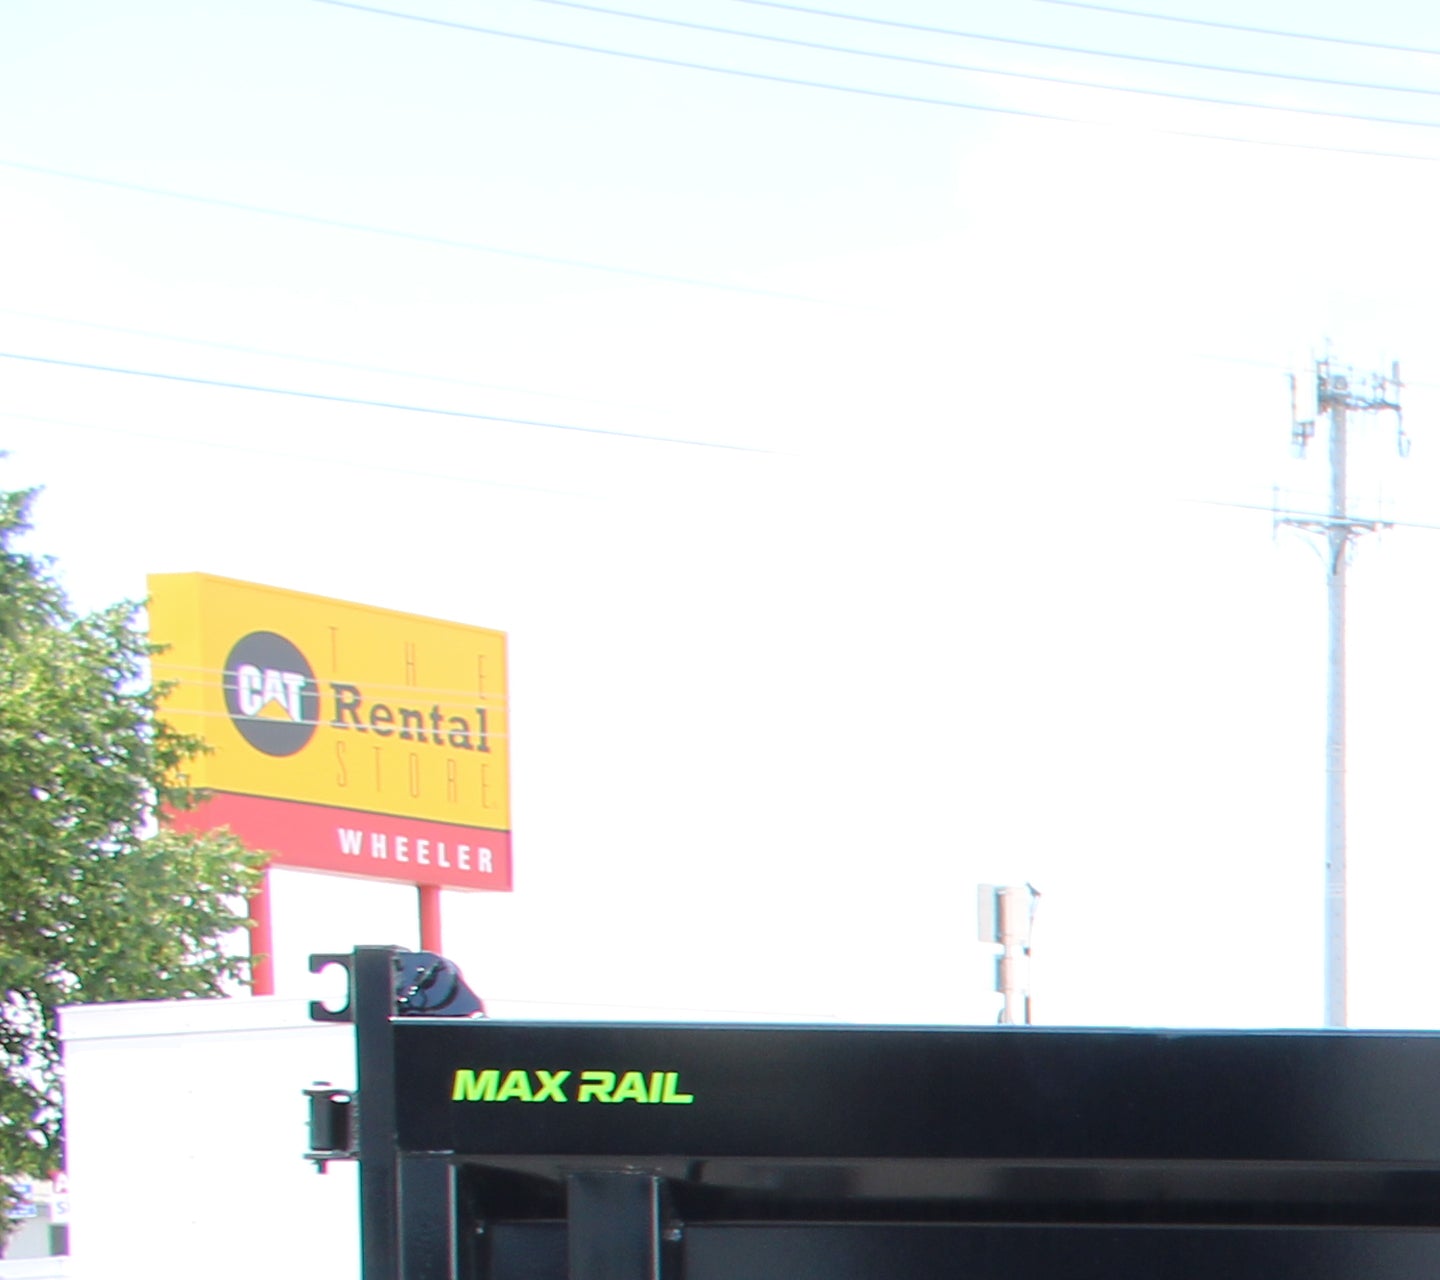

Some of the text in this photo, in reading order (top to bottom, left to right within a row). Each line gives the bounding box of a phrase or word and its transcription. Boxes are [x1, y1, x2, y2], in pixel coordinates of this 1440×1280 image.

[236, 663, 307, 722] CAT
[329, 626, 487, 700] THE
[329, 682, 492, 753] Rental
[336, 740, 490, 809] STORE
[337, 827, 494, 874] WHEELER
[452, 1069, 694, 1104] MAX RAIL
